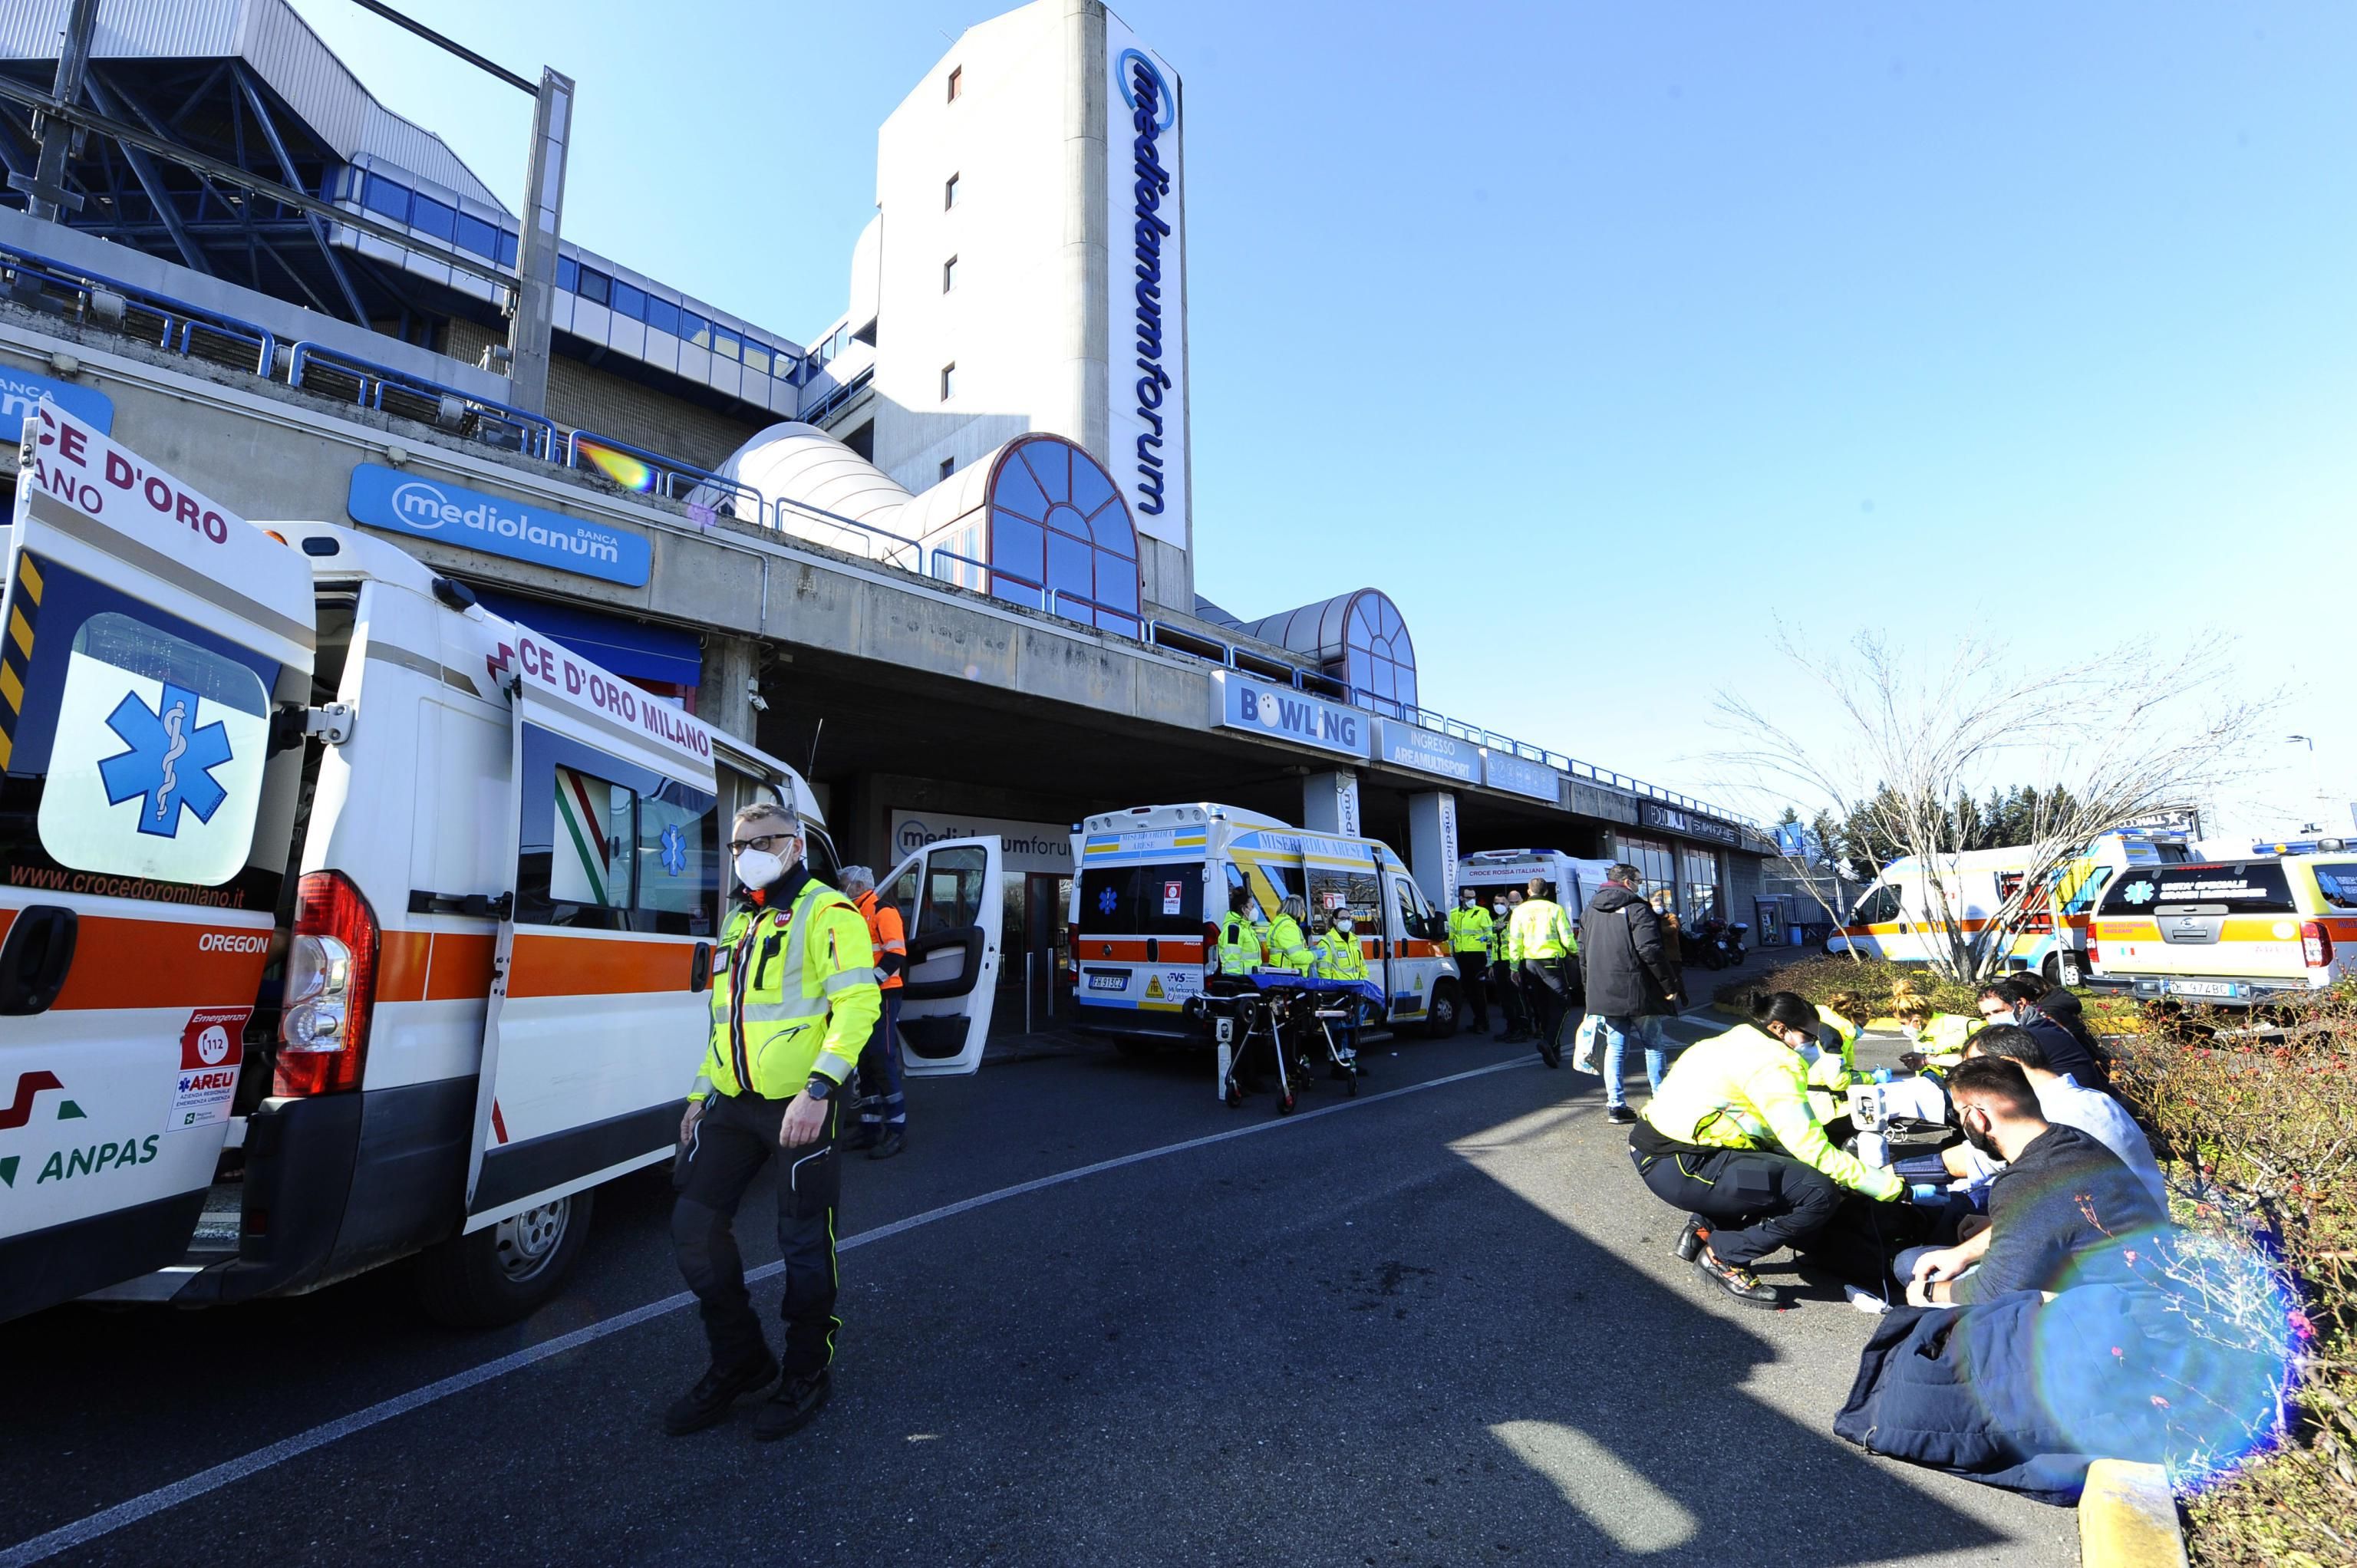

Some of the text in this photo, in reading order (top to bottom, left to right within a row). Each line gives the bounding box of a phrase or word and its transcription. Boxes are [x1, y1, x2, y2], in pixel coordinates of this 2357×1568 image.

[1133, 62, 1172, 516] mediolanumforum
[105, 450, 228, 545] D'ORO
[404, 493, 618, 563] mediolanum
[577, 528, 618, 546] BANCA
[519, 637, 709, 757] CE D'ORO MILANO
[1241, 687, 1356, 746] BOWLING
[1411, 730, 1455, 756] INGRESSO
[1394, 746, 1470, 779] AREAMULTISPORT
[1333, 841, 1363, 858] ARESE
[10, 865, 245, 909] www.crocedoromilano.it
[778, 912, 791, 921] 112
[199, 933, 269, 954] OREGON
[192, 1013, 247, 1023] Emergenza
[207, 1039, 223, 1050] 112
[180, 1091, 203, 1099] AZIENDA
[189, 1072, 234, 1092] AREU
[37, 1134, 160, 1184] ANPAS
